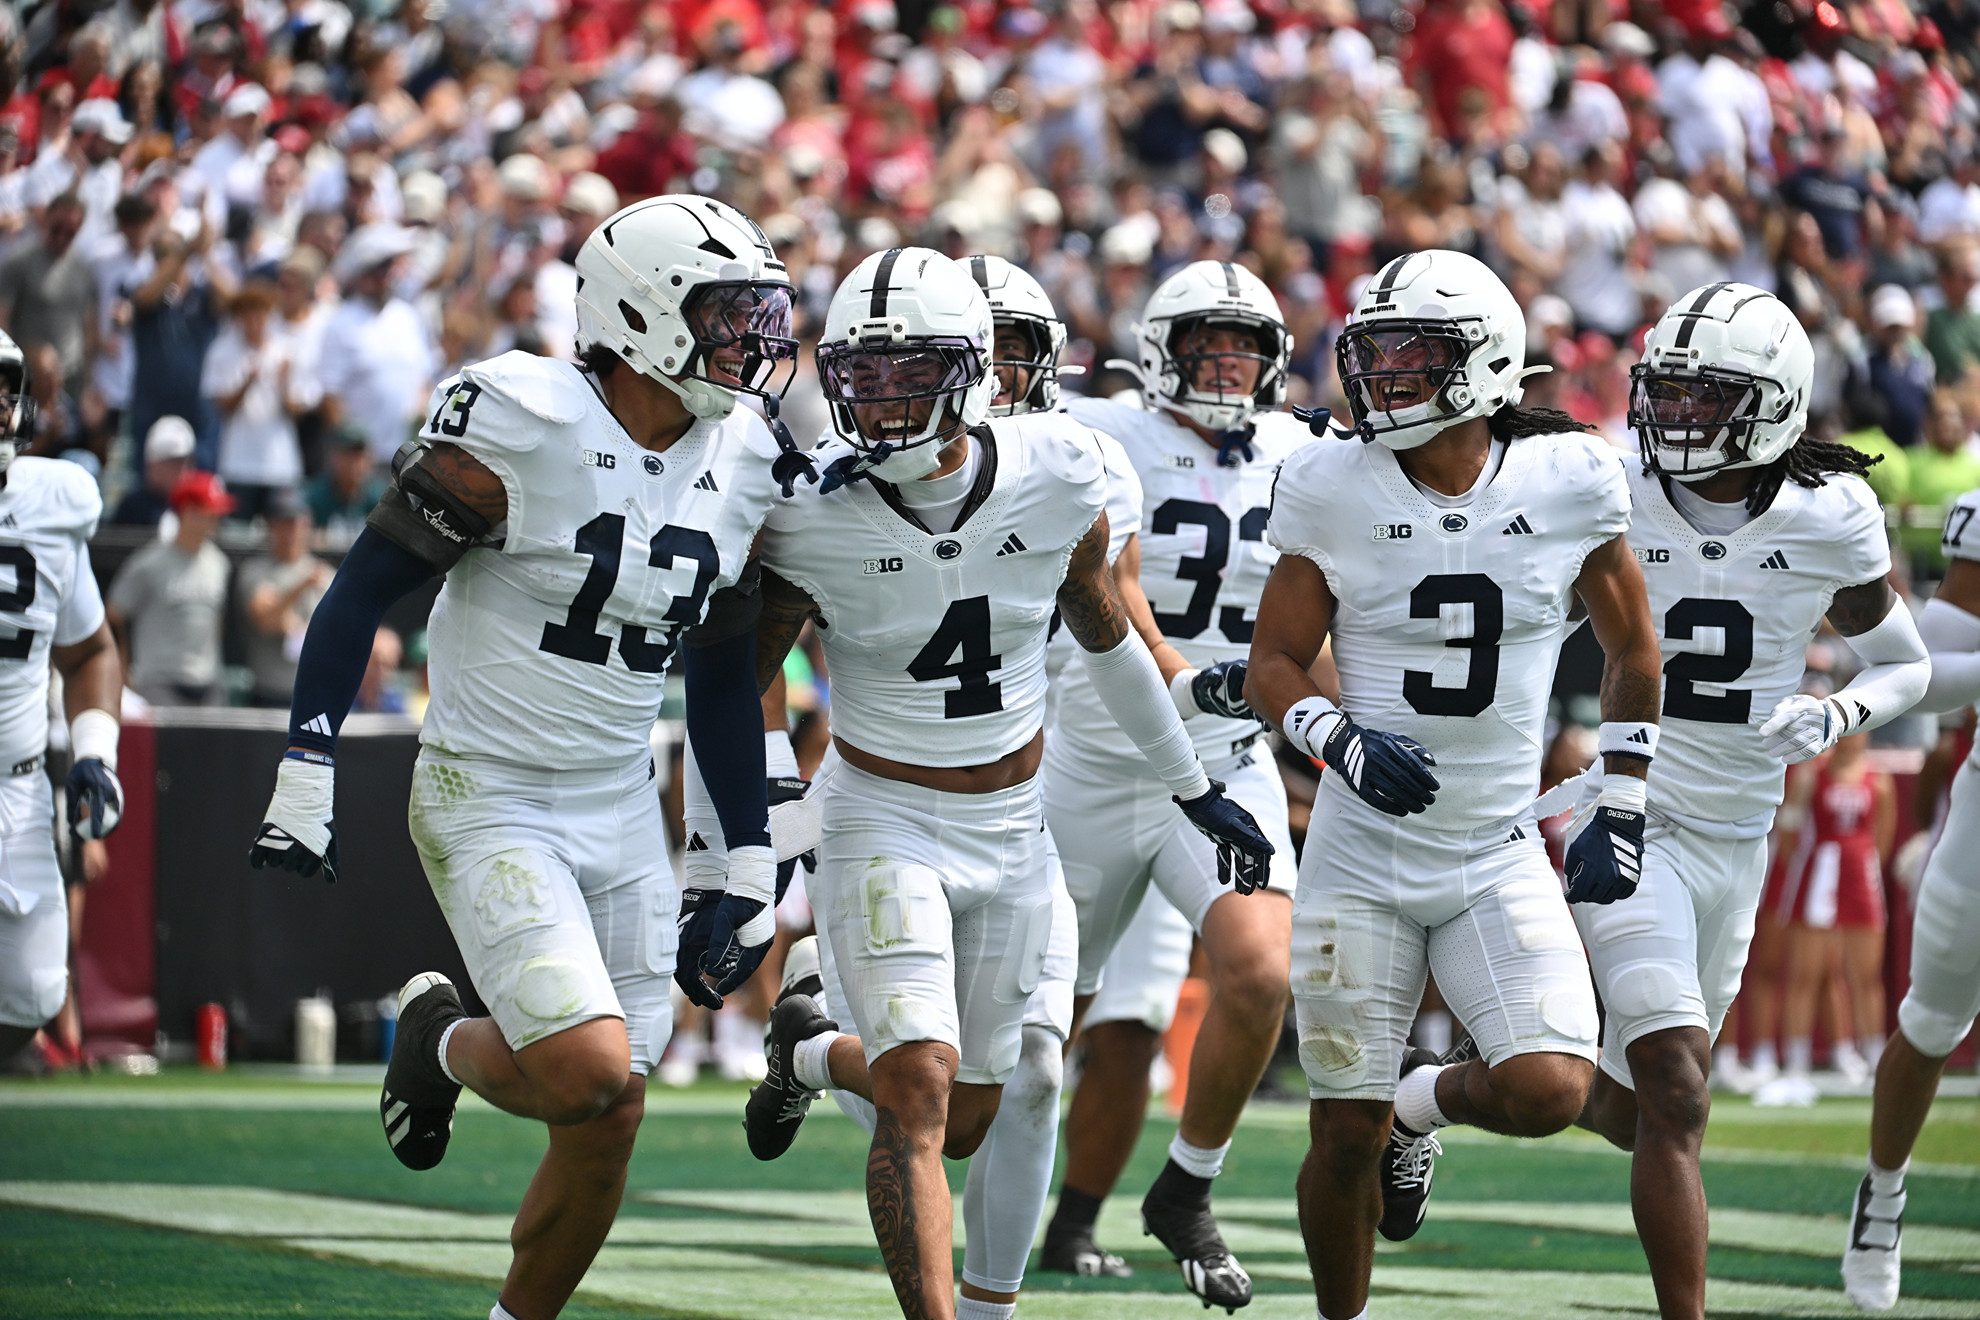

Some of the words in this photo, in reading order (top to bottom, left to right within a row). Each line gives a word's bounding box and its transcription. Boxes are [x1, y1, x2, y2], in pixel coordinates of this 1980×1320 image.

[1376, 303, 1397, 313] STATE
[431, 380, 483, 438] 13
[429, 517, 463, 543] Douglas
[1942, 504, 1977, 549] 17
[538, 511, 720, 673] 13
[904, 594, 1004, 719] 4
[1402, 573, 1504, 718] 3
[1661, 597, 1754, 724] 2
[1328, 716, 1348, 744] ADIZERO
[777, 779, 807, 790] ADIZERO
[1607, 809, 1637, 821] ADIZERO
[683, 892, 701, 902] ADIZER
